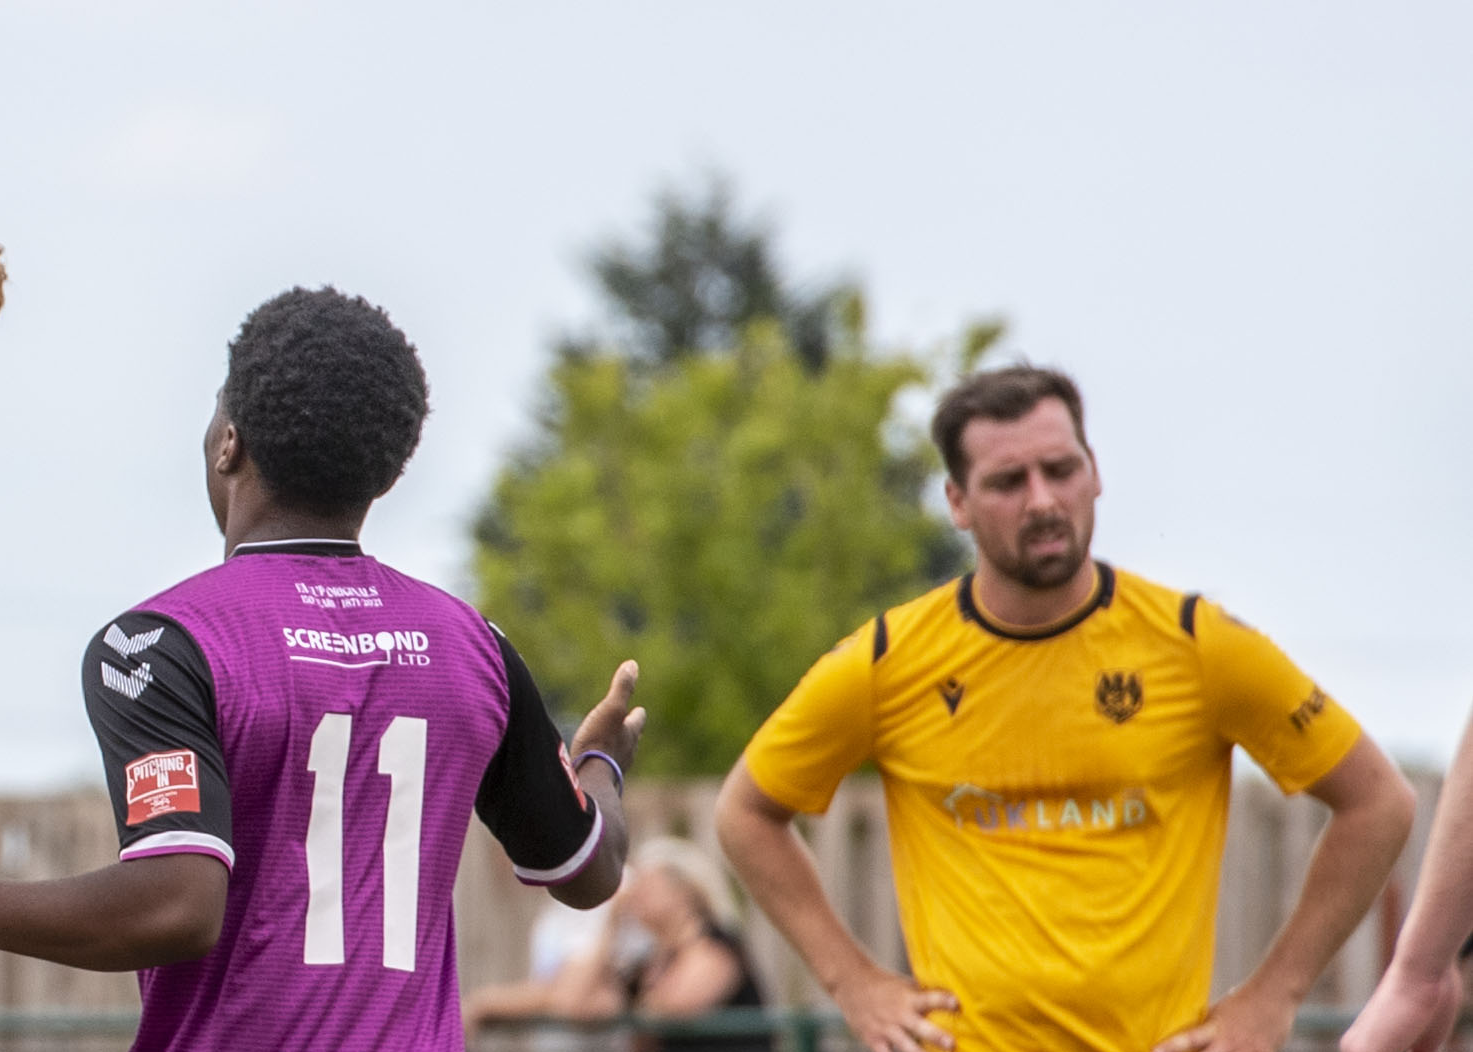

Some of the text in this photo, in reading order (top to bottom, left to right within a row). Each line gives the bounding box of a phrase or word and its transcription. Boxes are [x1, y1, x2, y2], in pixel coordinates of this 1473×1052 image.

[282, 627, 429, 655] SCREENBOND
[397, 653, 431, 666] LTD
[133, 756, 185, 783] PITCHING
[156, 770, 170, 788] IN
[973, 797, 1147, 832] UKLAND
[303, 712, 428, 972] 11
